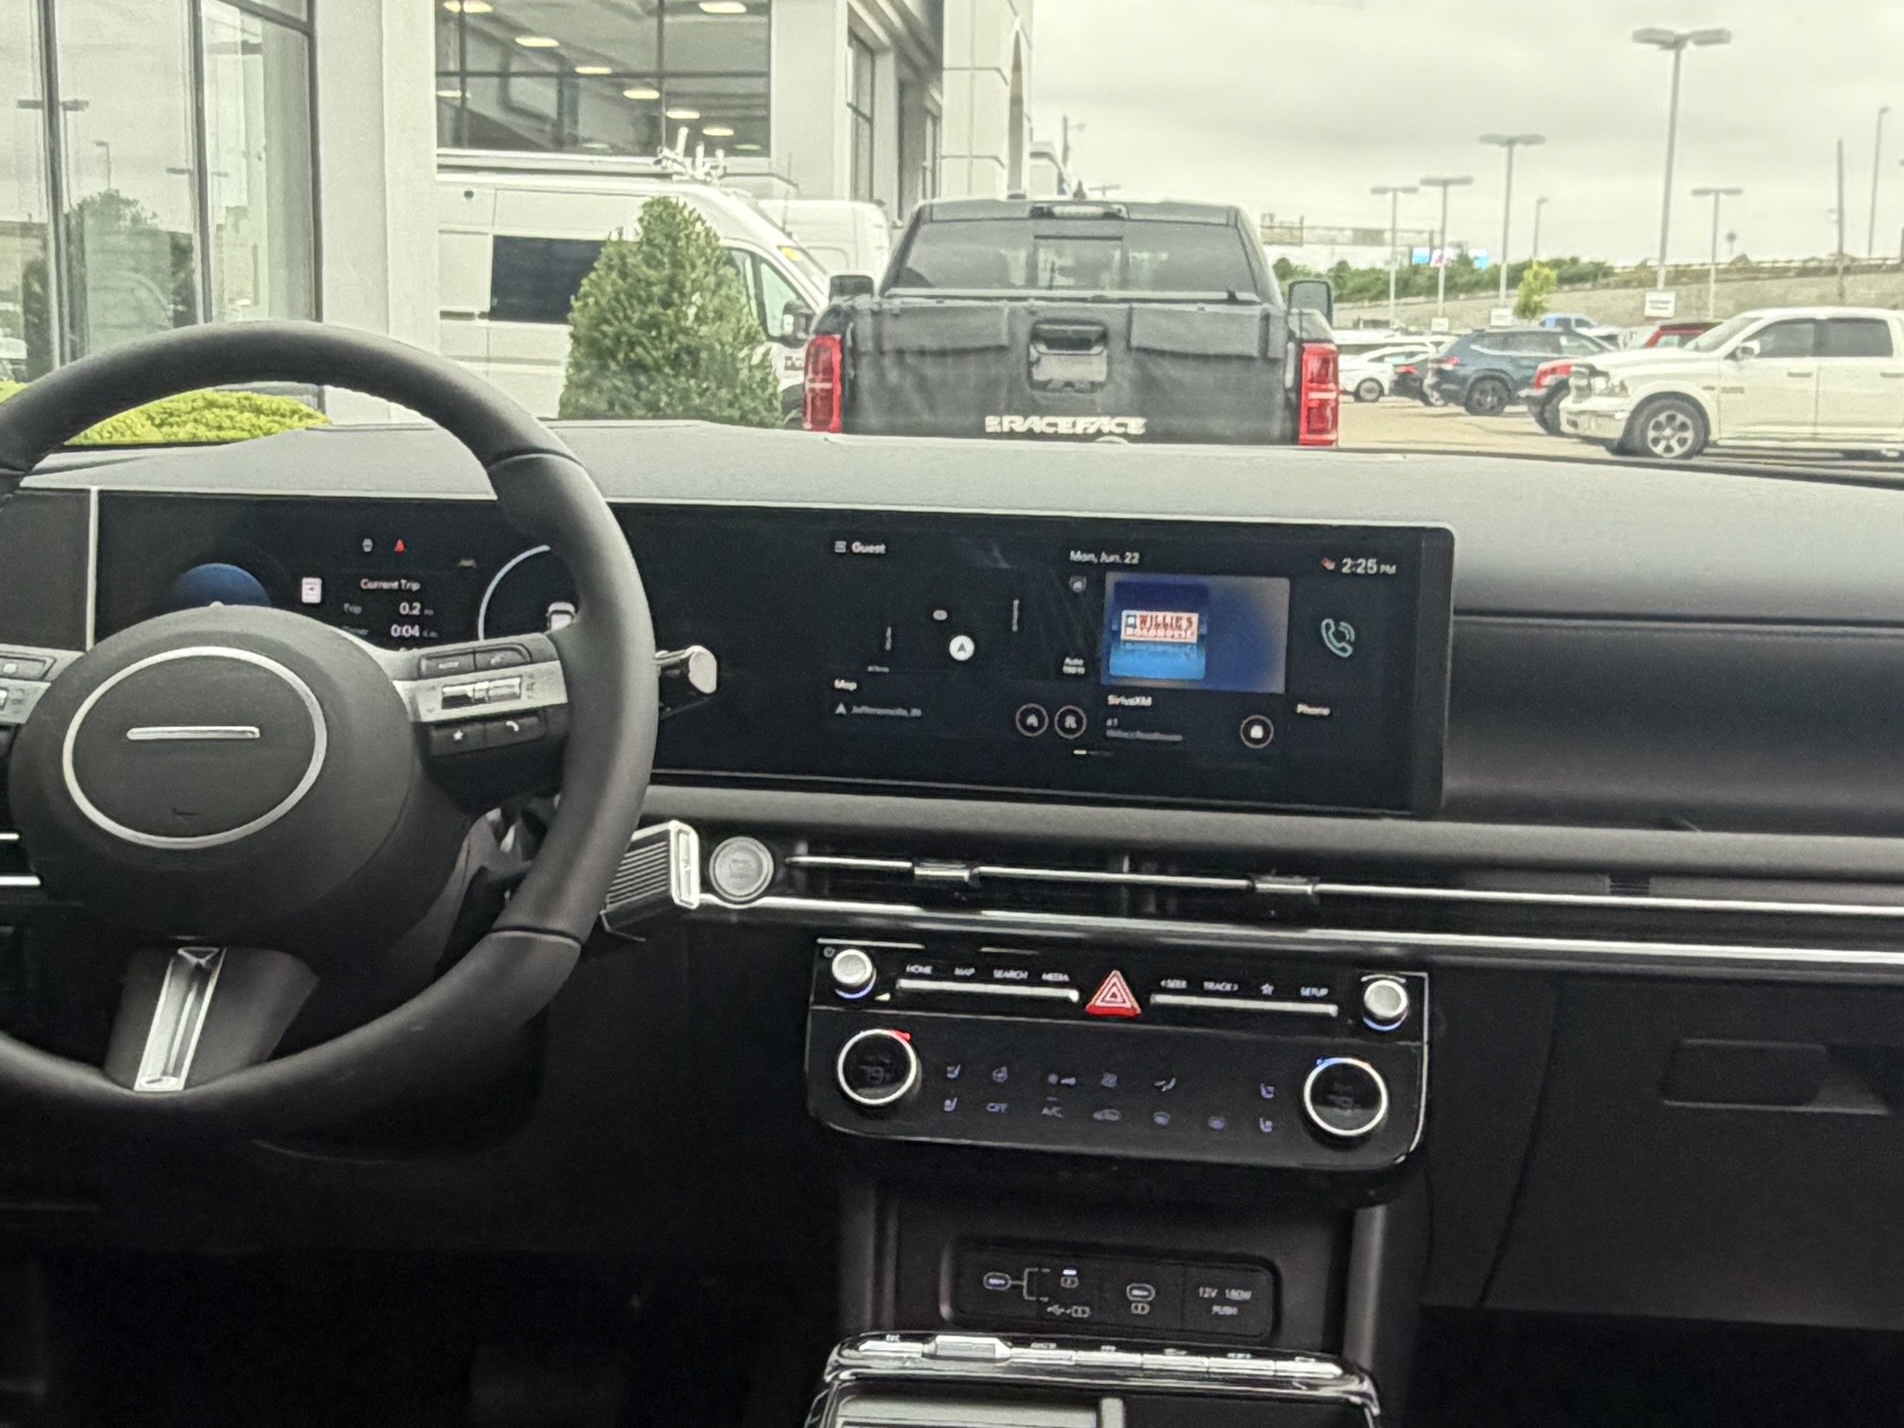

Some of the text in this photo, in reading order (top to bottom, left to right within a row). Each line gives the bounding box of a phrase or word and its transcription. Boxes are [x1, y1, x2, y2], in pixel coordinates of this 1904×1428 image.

[1070, 550, 1098, 564] Mon,
[1341, 557, 1377, 574] 2:25
[359, 577, 422, 592] Current Trip
[399, 600, 422, 616] 0.2
[390, 623, 421, 638] 0:04
[906, 964, 933, 974] HOME
[993, 969, 1029, 980] SEARCH
